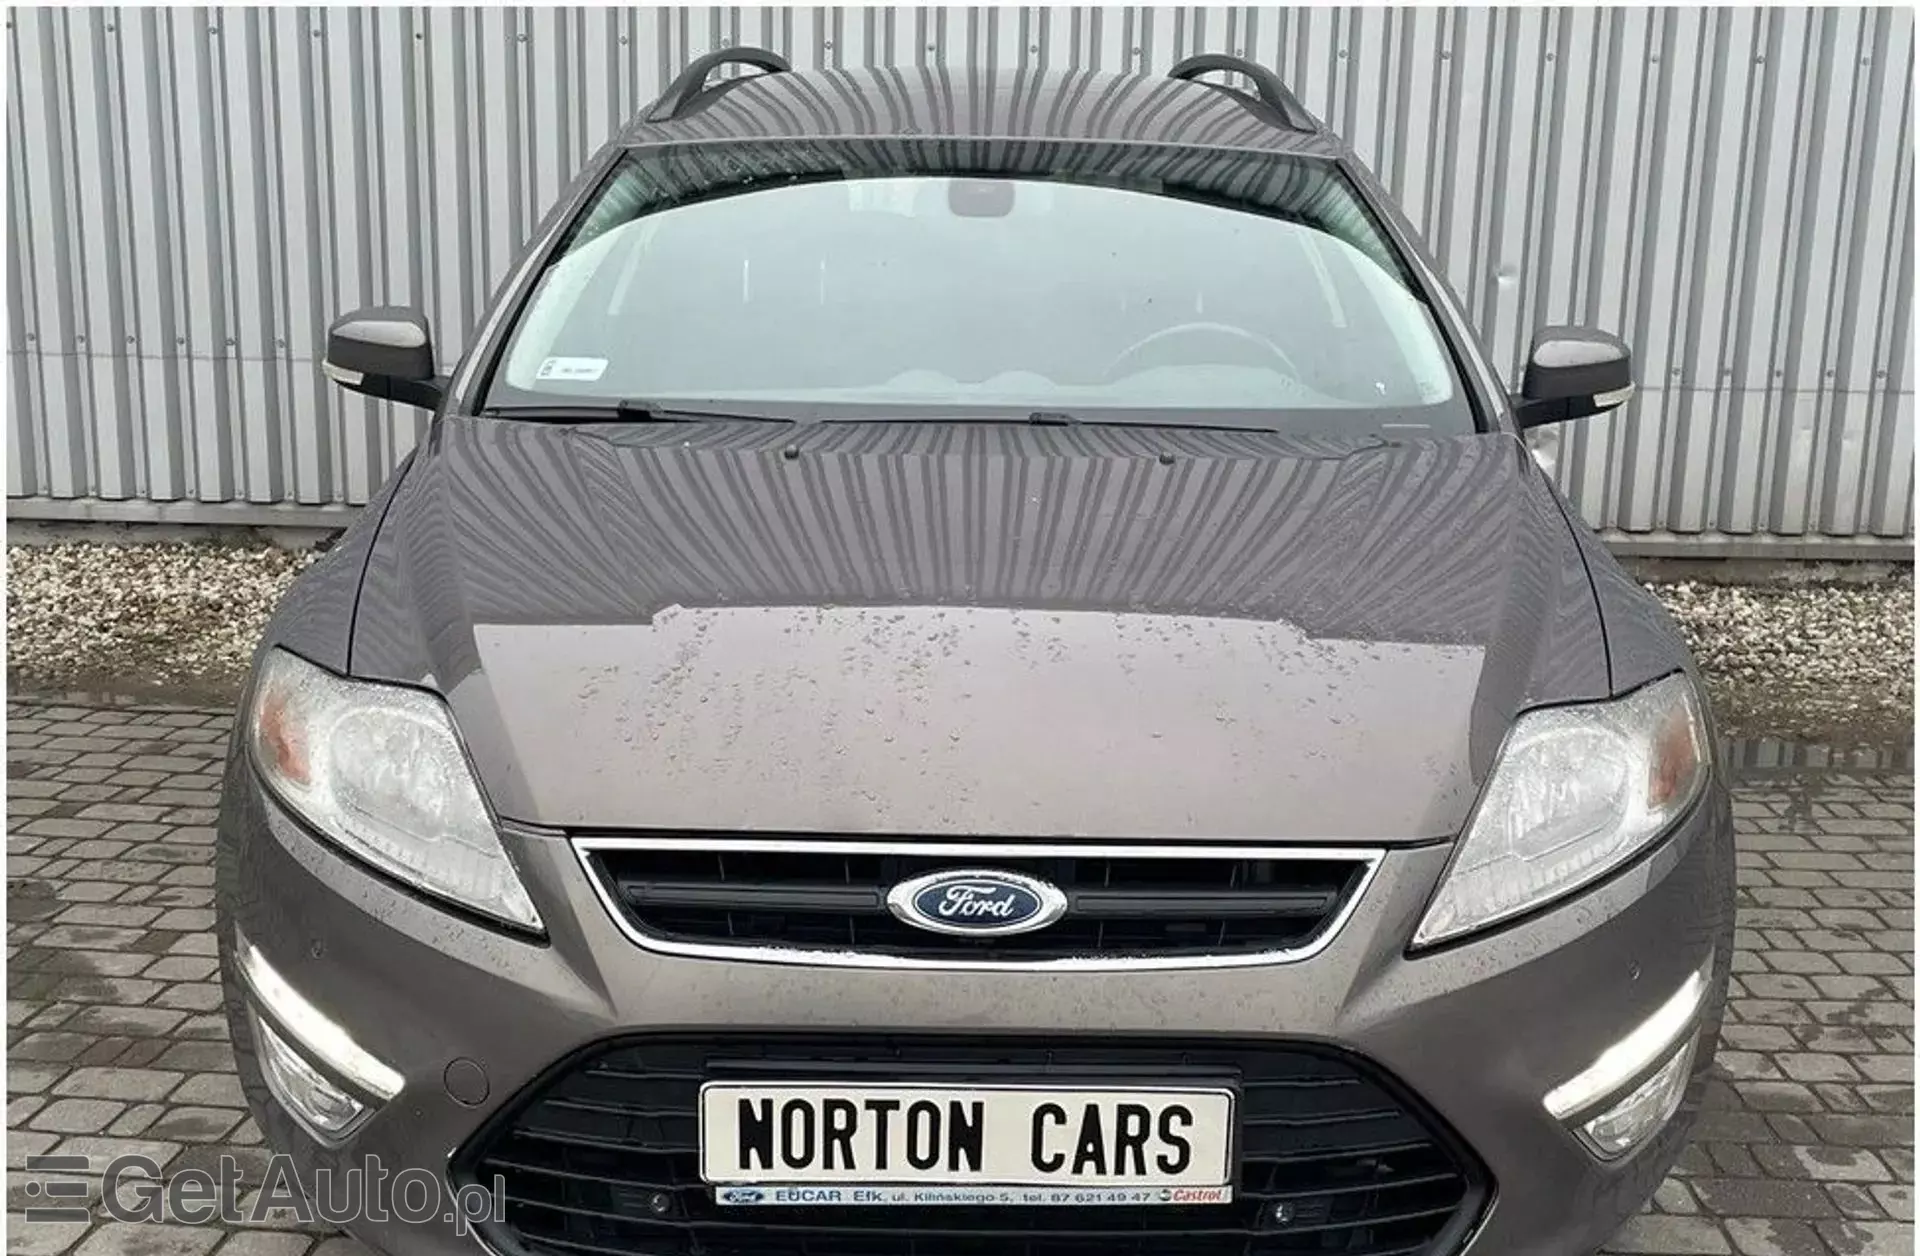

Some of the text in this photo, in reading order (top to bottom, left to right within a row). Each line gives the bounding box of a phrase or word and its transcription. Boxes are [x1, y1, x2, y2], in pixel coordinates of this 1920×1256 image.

[938, 885, 1016, 917] Ford
[738, 1097, 1193, 1176] NORTON CARS
[1173, 1188, 1223, 1202] Castrol
